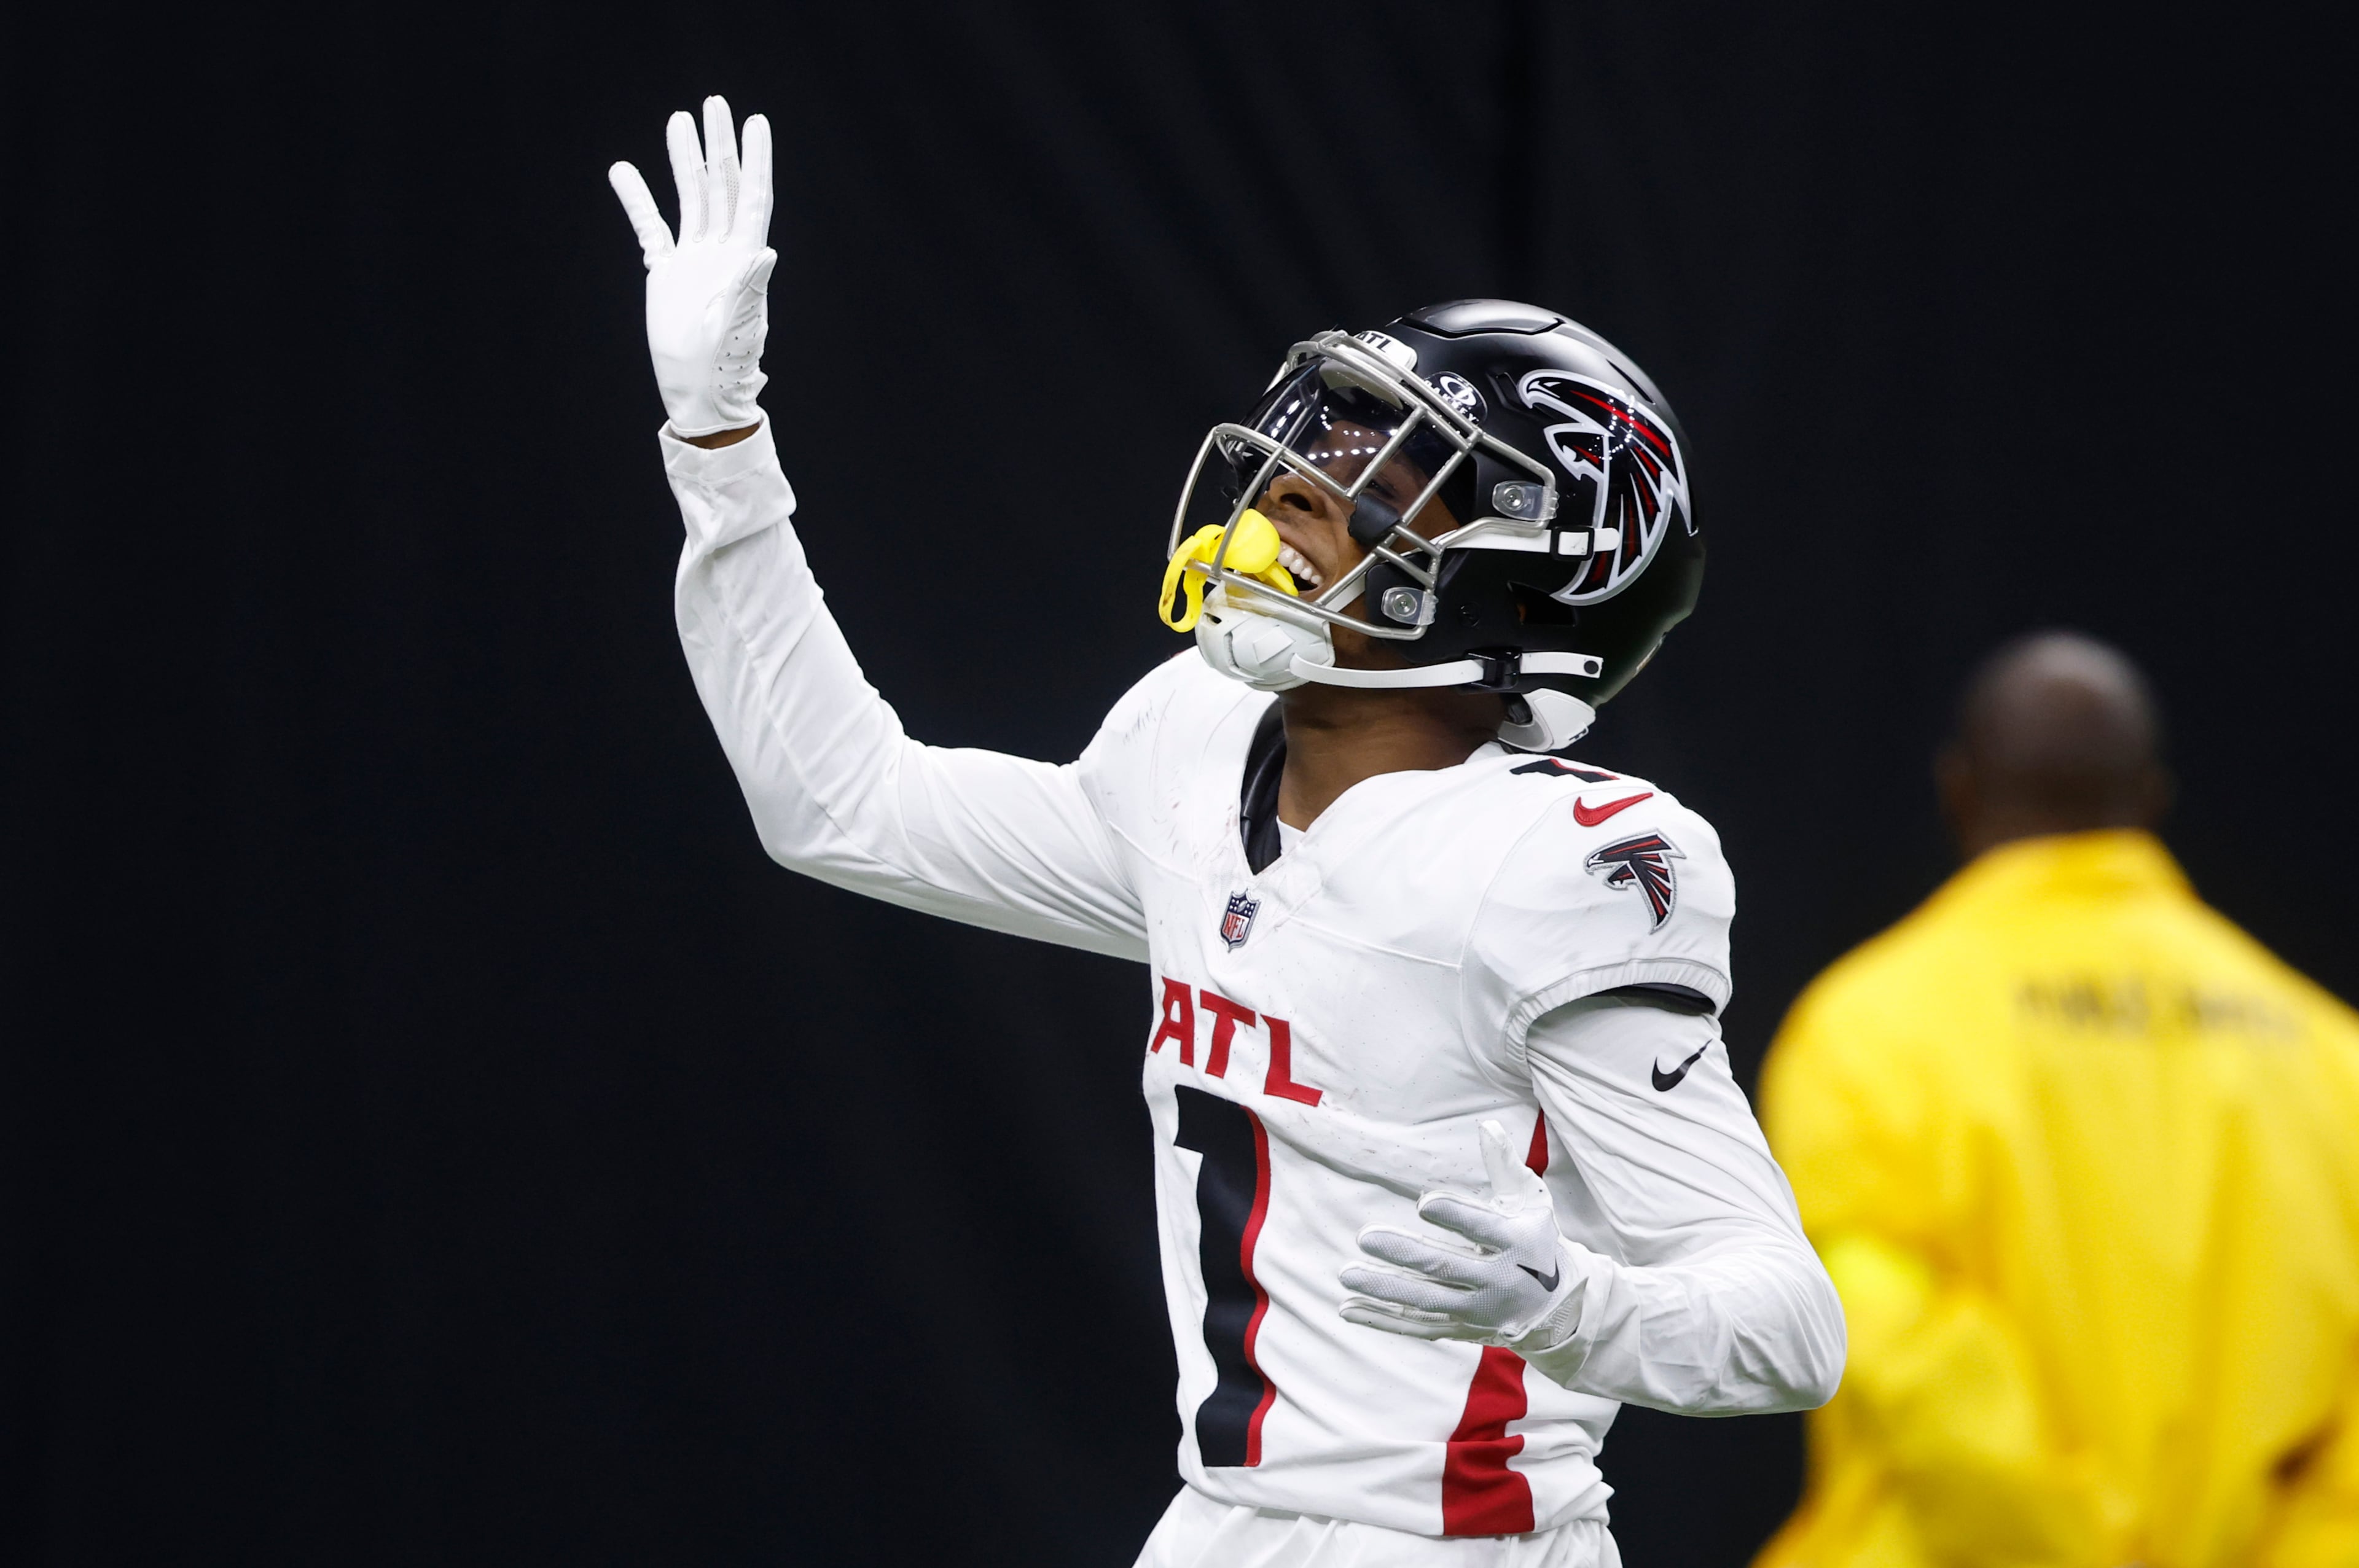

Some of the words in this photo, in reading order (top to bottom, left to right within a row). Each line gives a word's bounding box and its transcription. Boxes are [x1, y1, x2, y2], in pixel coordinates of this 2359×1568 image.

[1224, 913, 1245, 939] NFL
[1151, 976, 1323, 1107] ATL
[1174, 1084, 1277, 1467] 1
